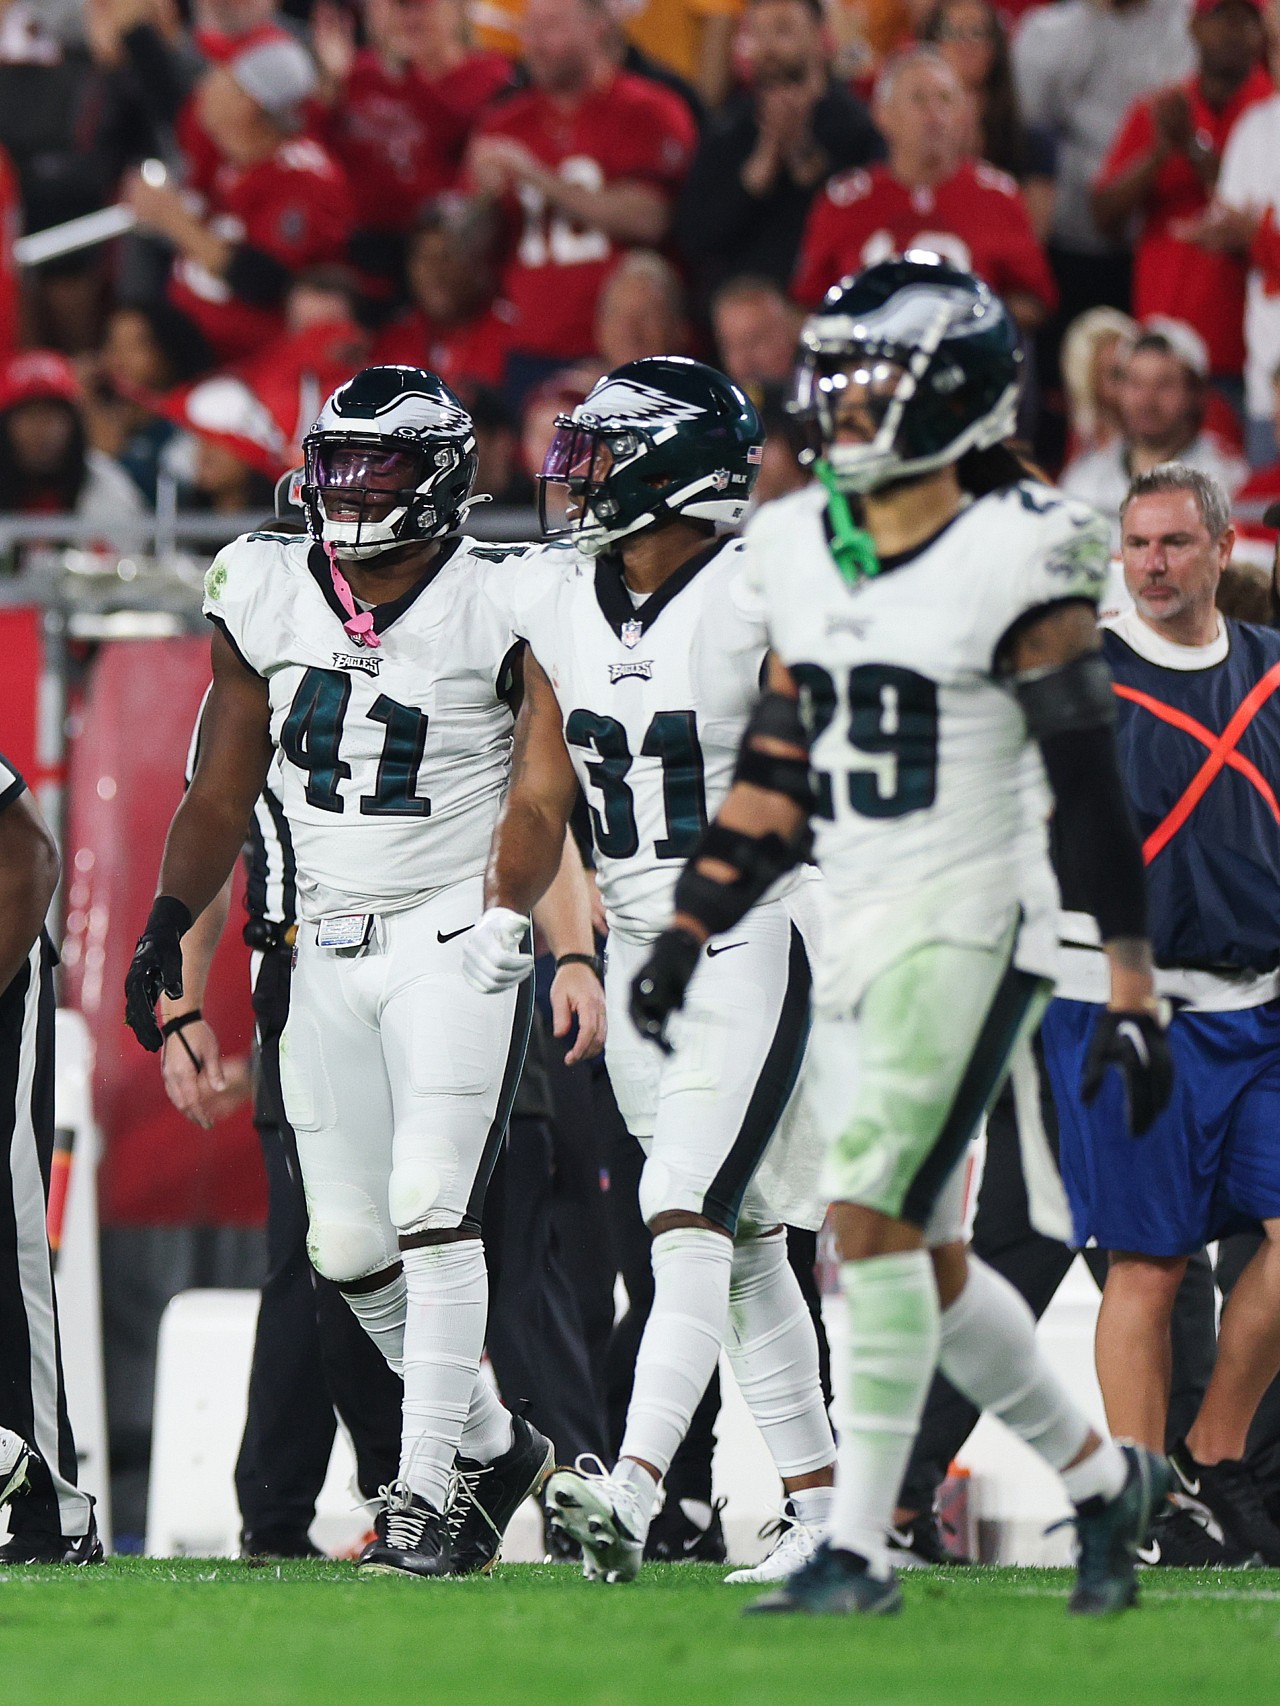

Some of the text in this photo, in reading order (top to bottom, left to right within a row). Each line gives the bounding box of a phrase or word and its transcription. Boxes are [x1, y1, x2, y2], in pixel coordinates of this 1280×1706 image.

[332, 652, 384, 678] EAGLES
[280, 666, 431, 817] 41
[566, 709, 708, 860] 31
[790, 663, 939, 821] 29
